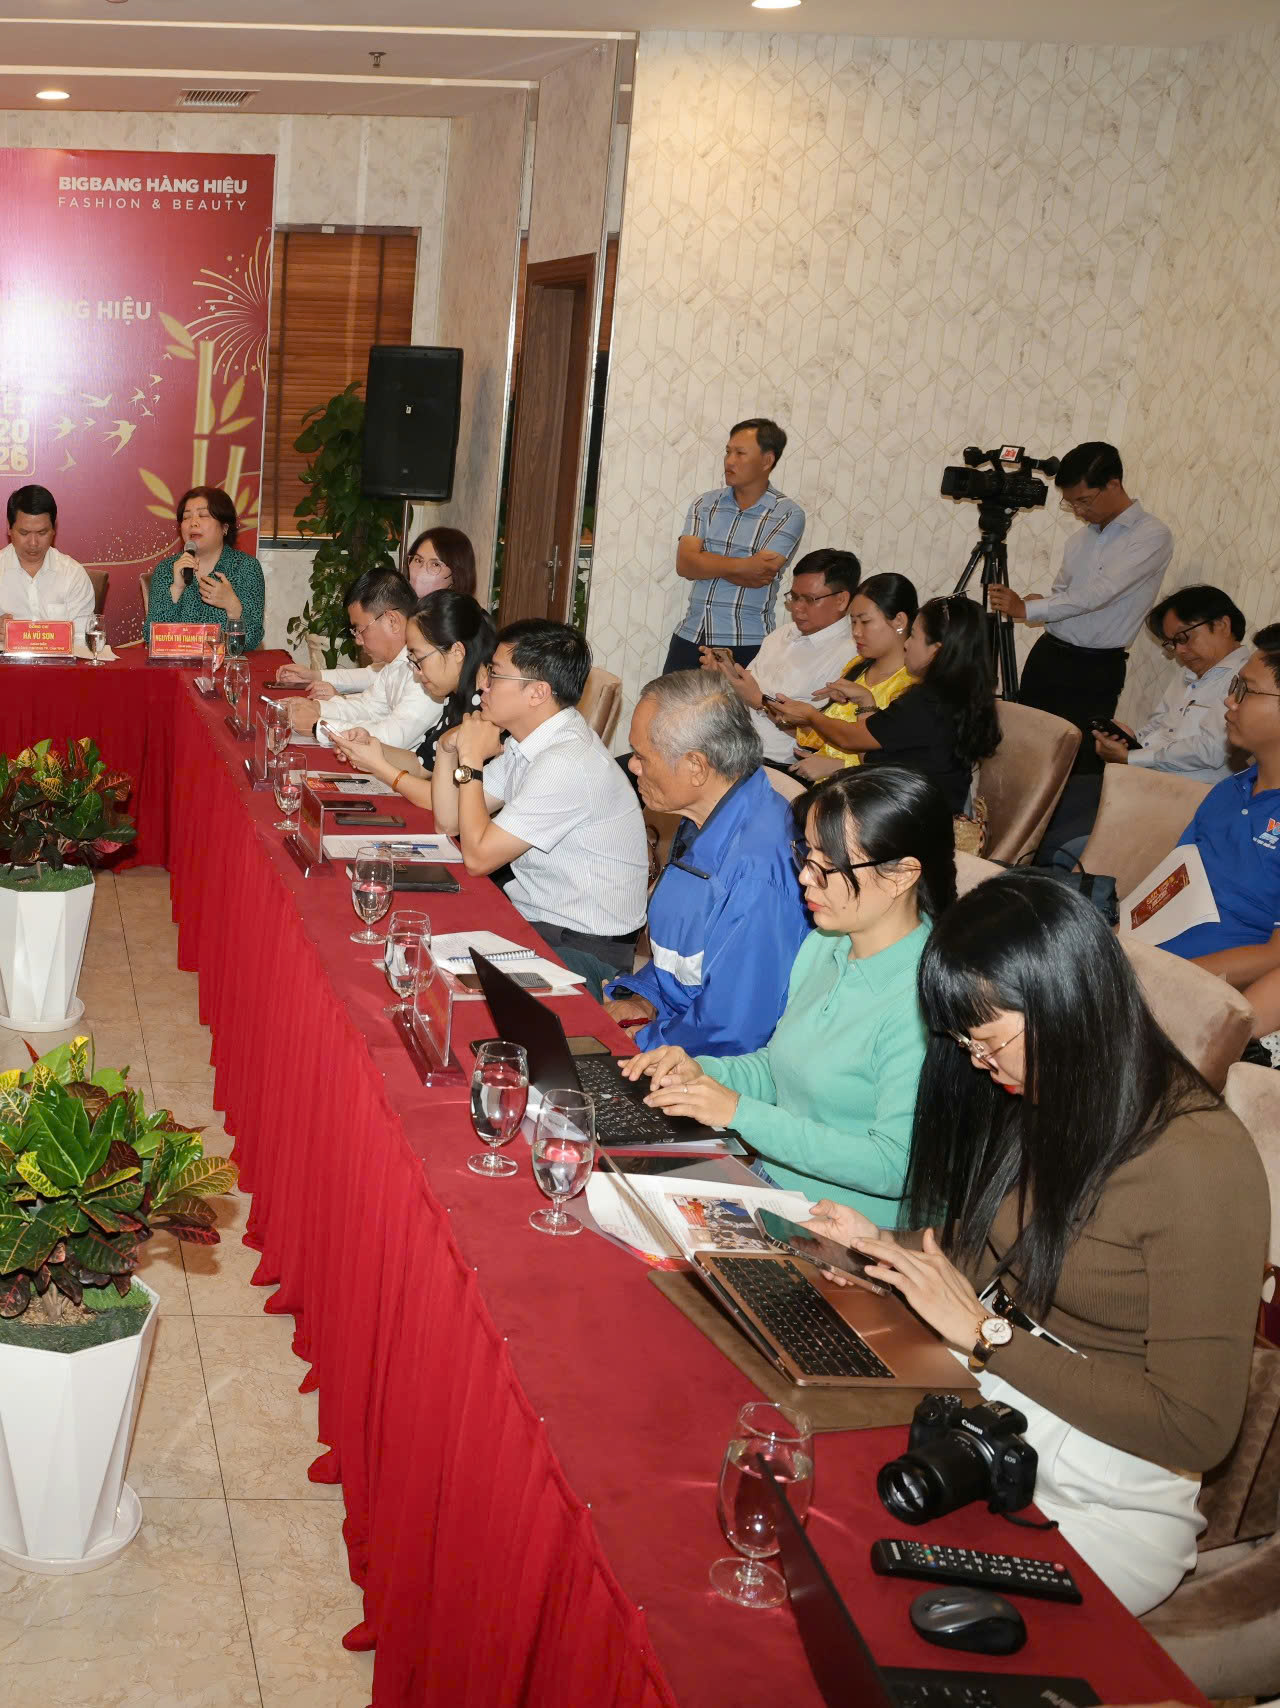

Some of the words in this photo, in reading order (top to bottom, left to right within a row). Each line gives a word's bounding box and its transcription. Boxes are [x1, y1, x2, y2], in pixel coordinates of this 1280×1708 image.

[58, 176, 142, 192] BIGBANG
[146, 174, 200, 193] HÀNG
[203, 175, 248, 198] HIỆU
[58, 196, 140, 209] FASHION
[151, 198, 161, 210] &
[172, 199, 247, 211] BEAUTY
[97, 296, 152, 326] HIỆU
[961, 1418, 983, 1435] Canon
[1004, 1454, 1017, 1464] EOS
